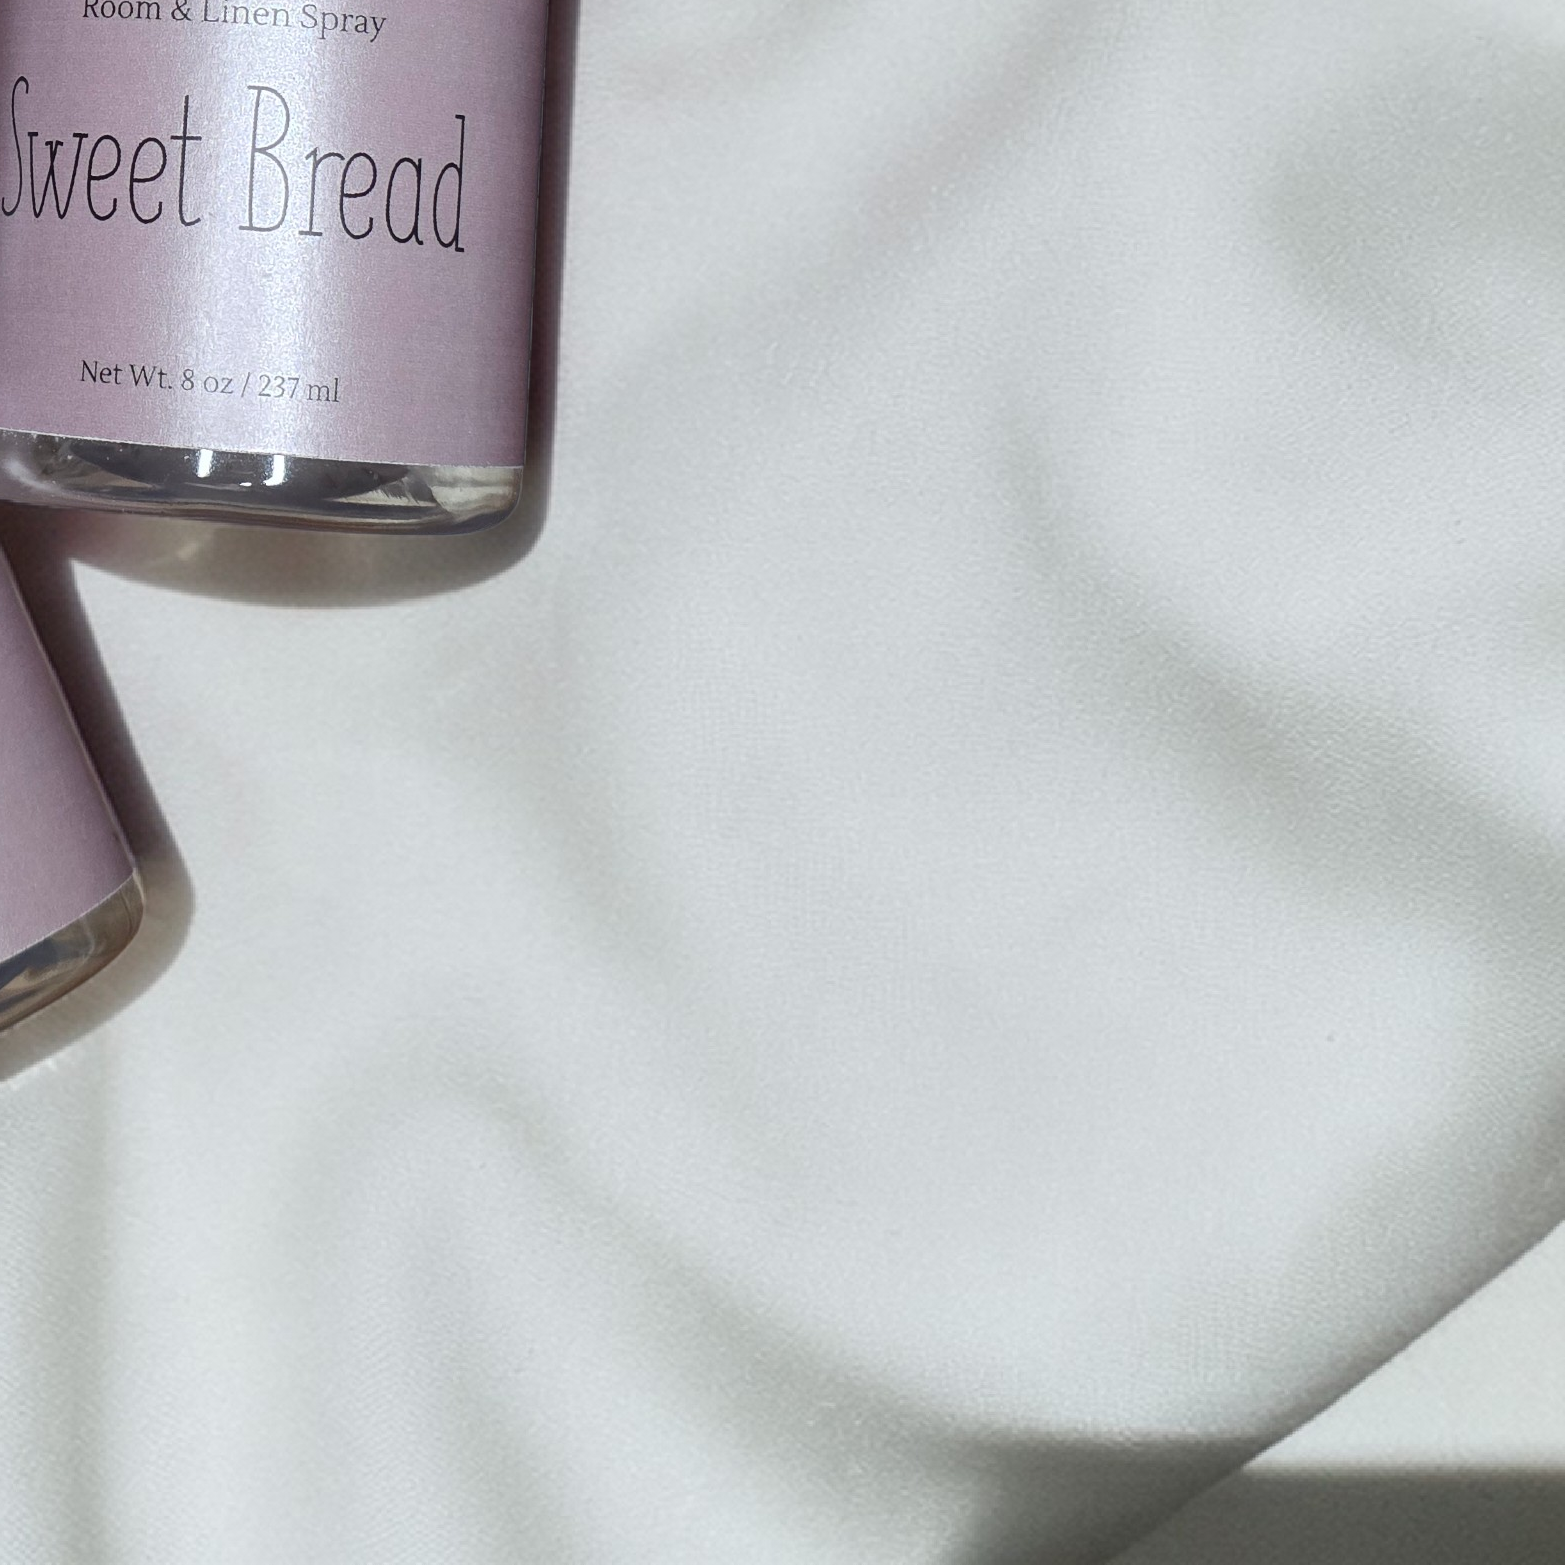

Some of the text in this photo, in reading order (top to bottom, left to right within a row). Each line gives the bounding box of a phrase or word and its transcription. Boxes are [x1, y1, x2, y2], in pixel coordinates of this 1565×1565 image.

[300, 3, 388, 43] Spray
[1, 75, 466, 253] Sweet Bread
[80, 360, 341, 404] Net Wt. 8 oz / 237 ml
